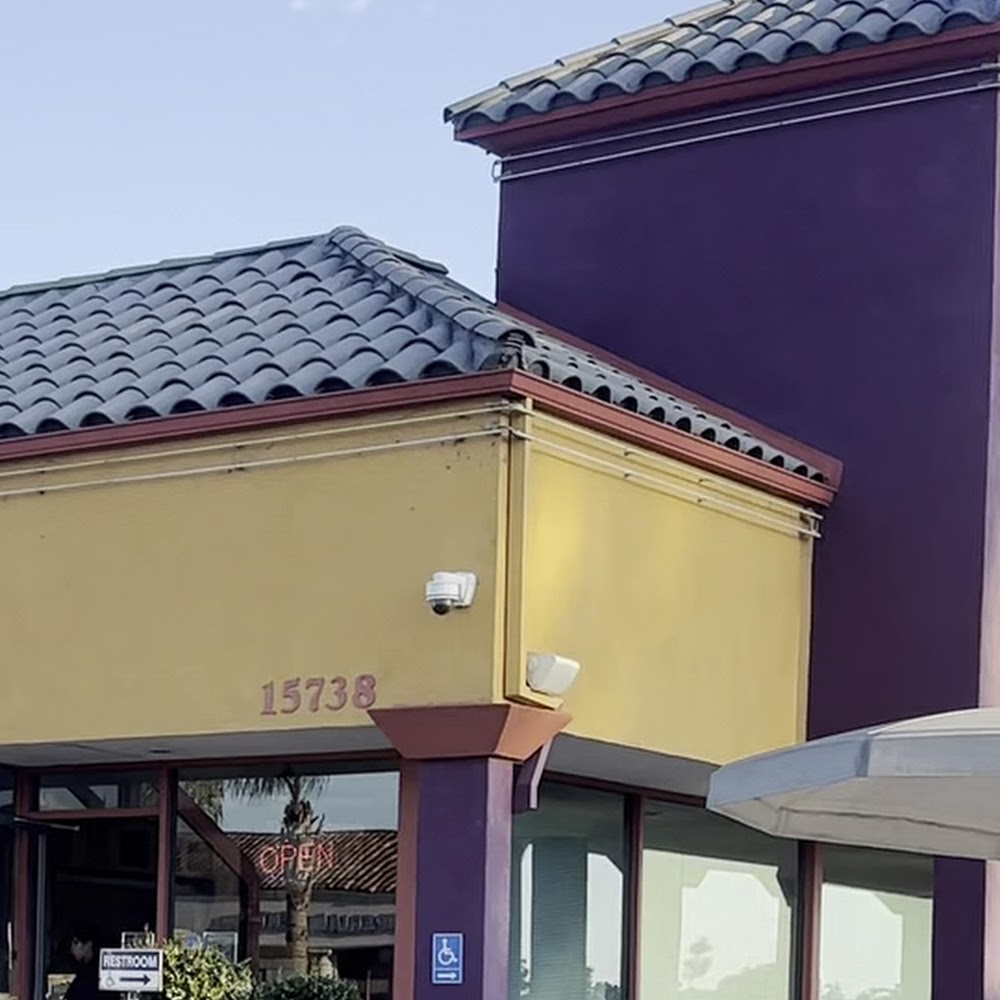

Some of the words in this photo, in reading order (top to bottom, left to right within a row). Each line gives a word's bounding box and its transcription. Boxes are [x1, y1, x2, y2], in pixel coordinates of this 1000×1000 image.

[260, 674, 377, 715] 15738
[259, 842, 335, 875] OPEN
[103, 954, 158, 968] RESTROOM
